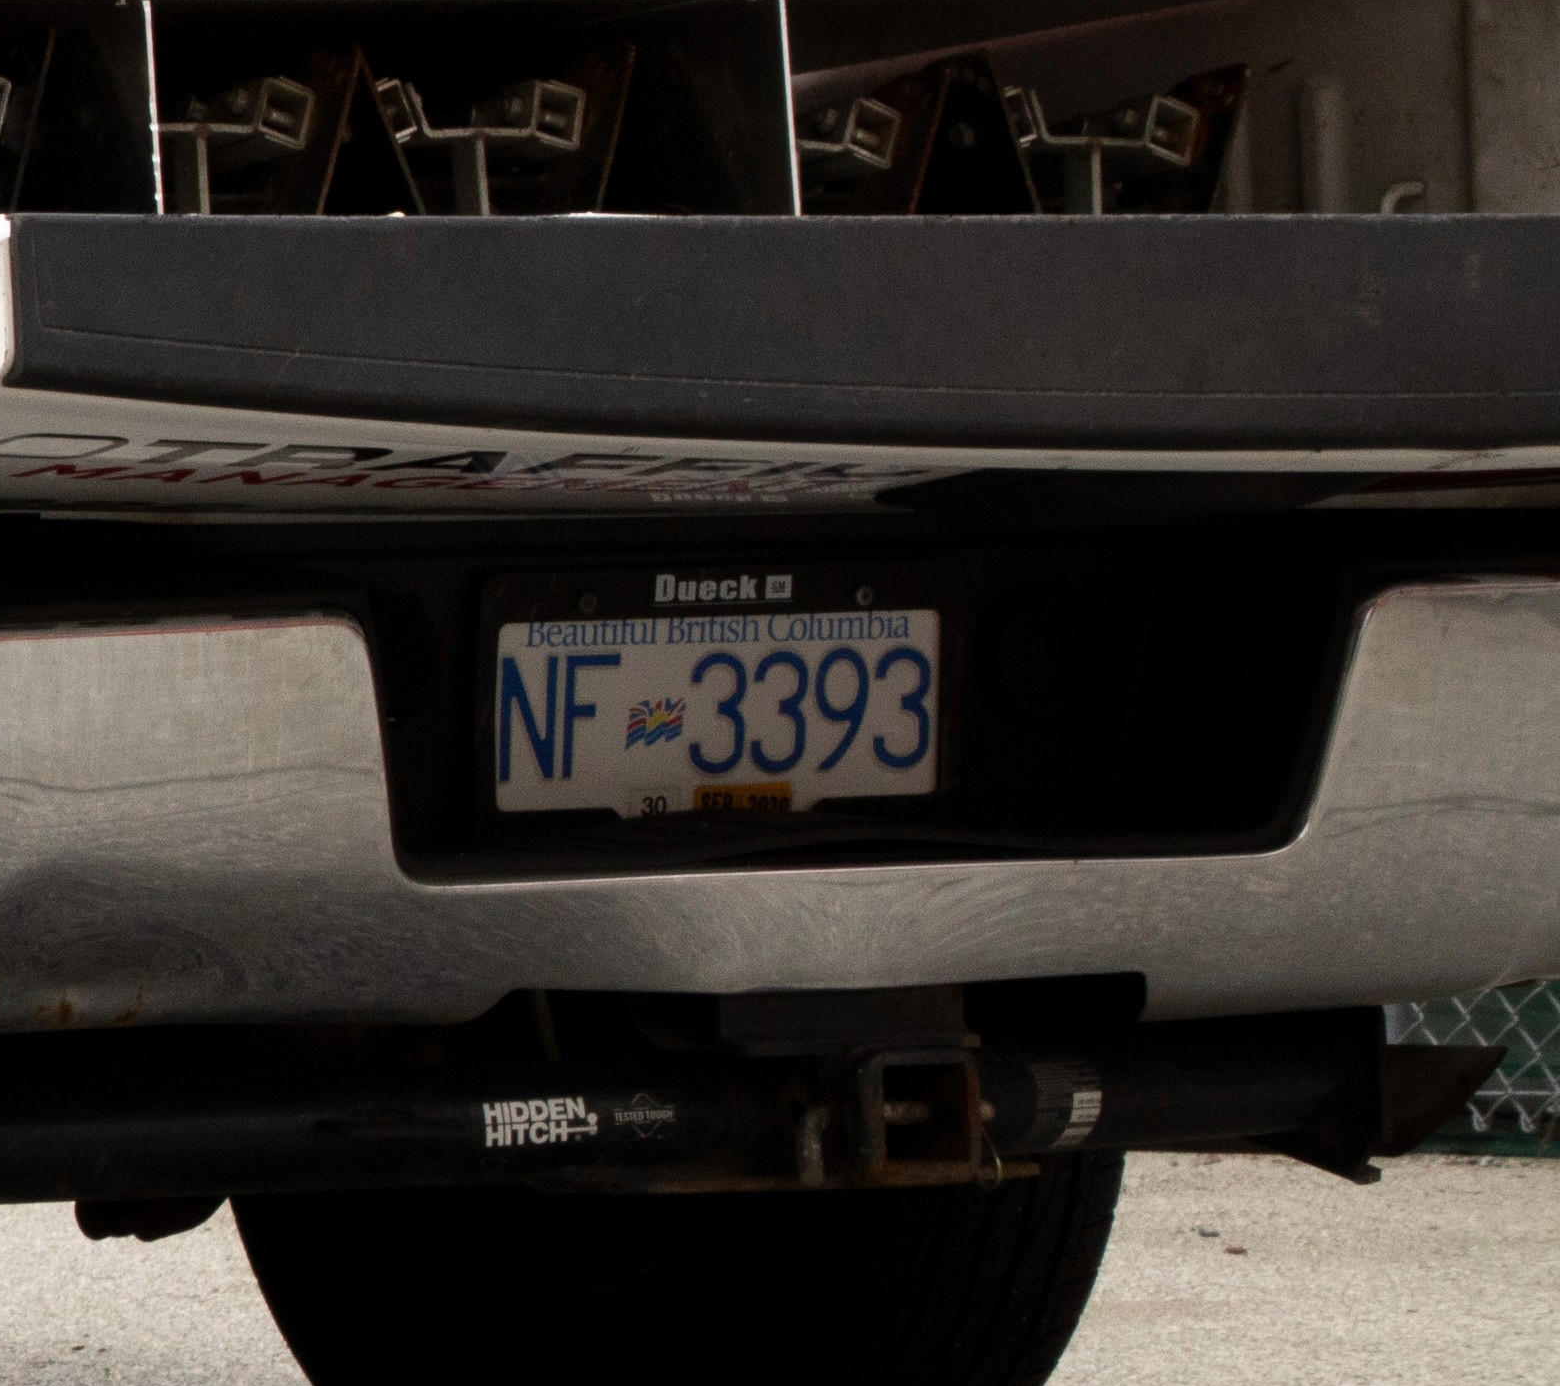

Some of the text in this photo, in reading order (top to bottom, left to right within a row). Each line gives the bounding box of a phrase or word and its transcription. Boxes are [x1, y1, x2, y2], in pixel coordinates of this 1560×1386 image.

[655, 574, 757, 602] Dueck
[526, 611, 910, 649] Beautiful British Columbia
[499, 647, 932, 782] NF 3393
[482, 1097, 586, 1125] HIDDEN
[614, 1110, 644, 1123] TESTED
[485, 1121, 569, 1147] HITCH
